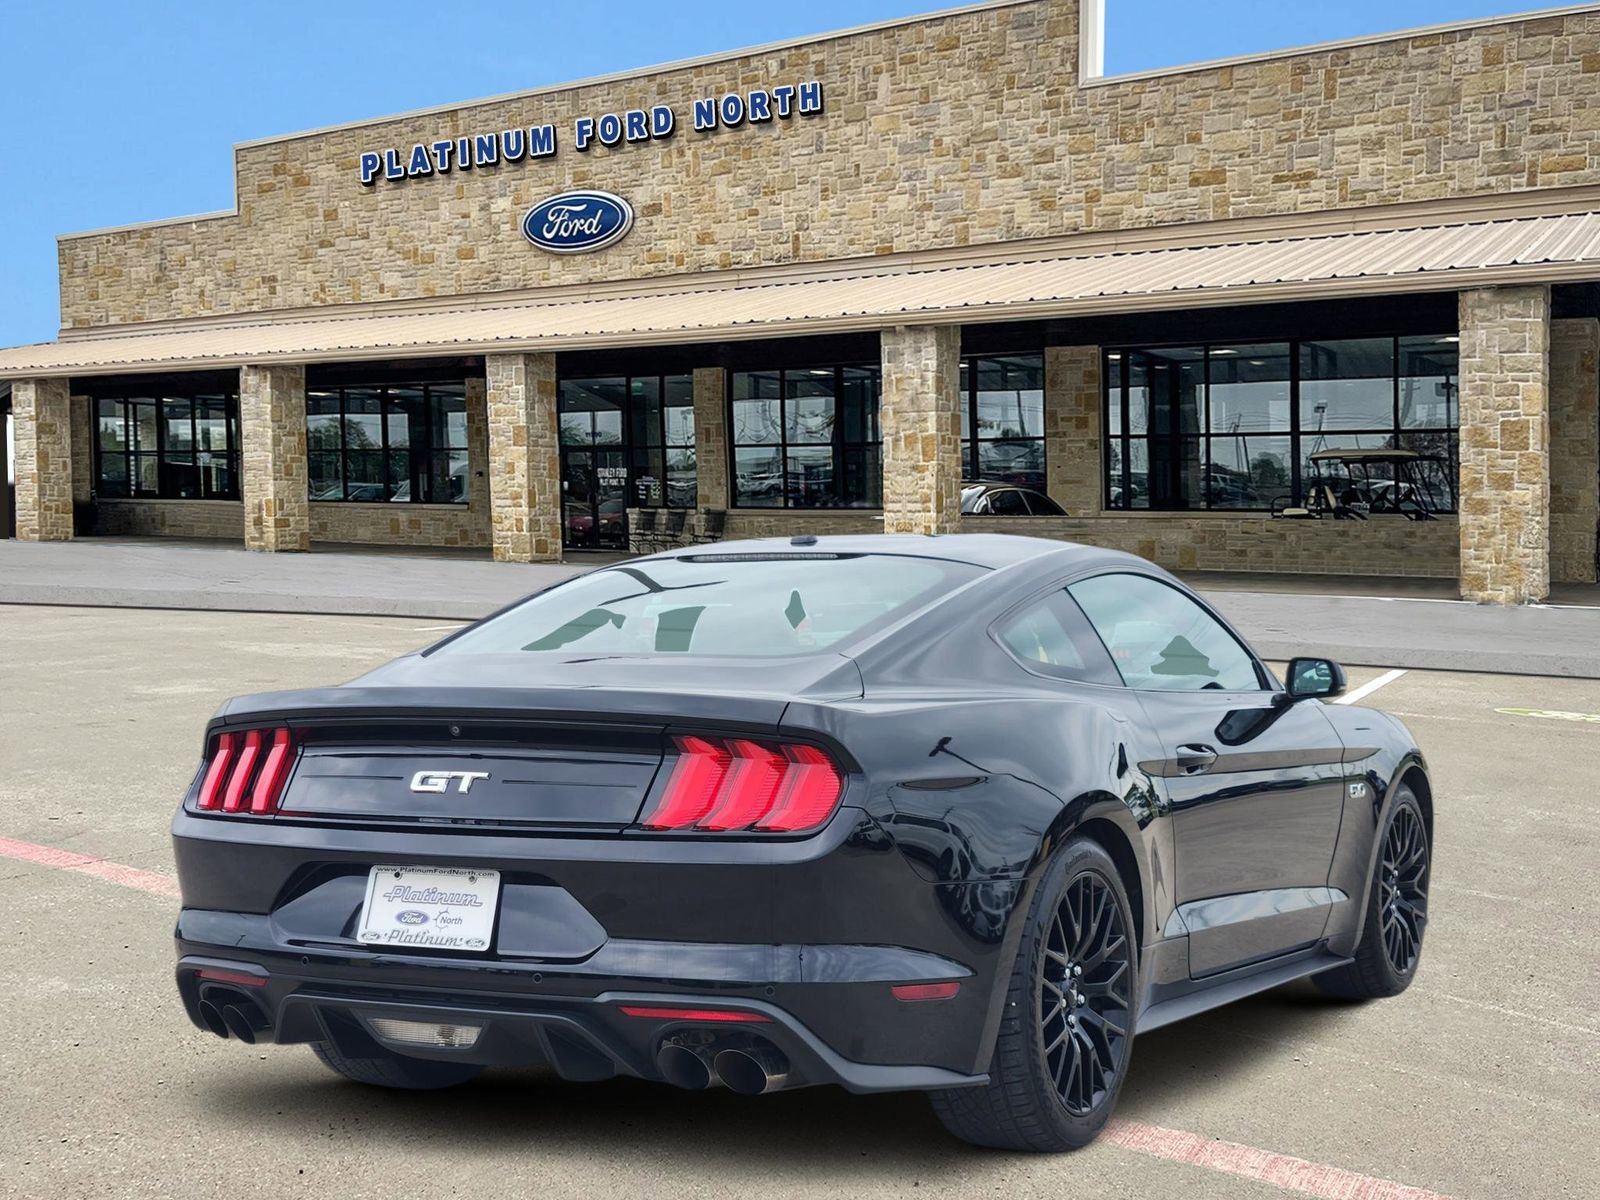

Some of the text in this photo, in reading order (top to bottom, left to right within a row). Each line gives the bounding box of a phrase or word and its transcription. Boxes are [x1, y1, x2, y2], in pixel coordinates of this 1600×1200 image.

[360, 81, 823, 186] PLATINUM FORD NORTH
[542, 203, 602, 240] Ford
[410, 770, 492, 794] GT
[383, 885, 483, 907] Platinum
[440, 915, 463, 926] North
